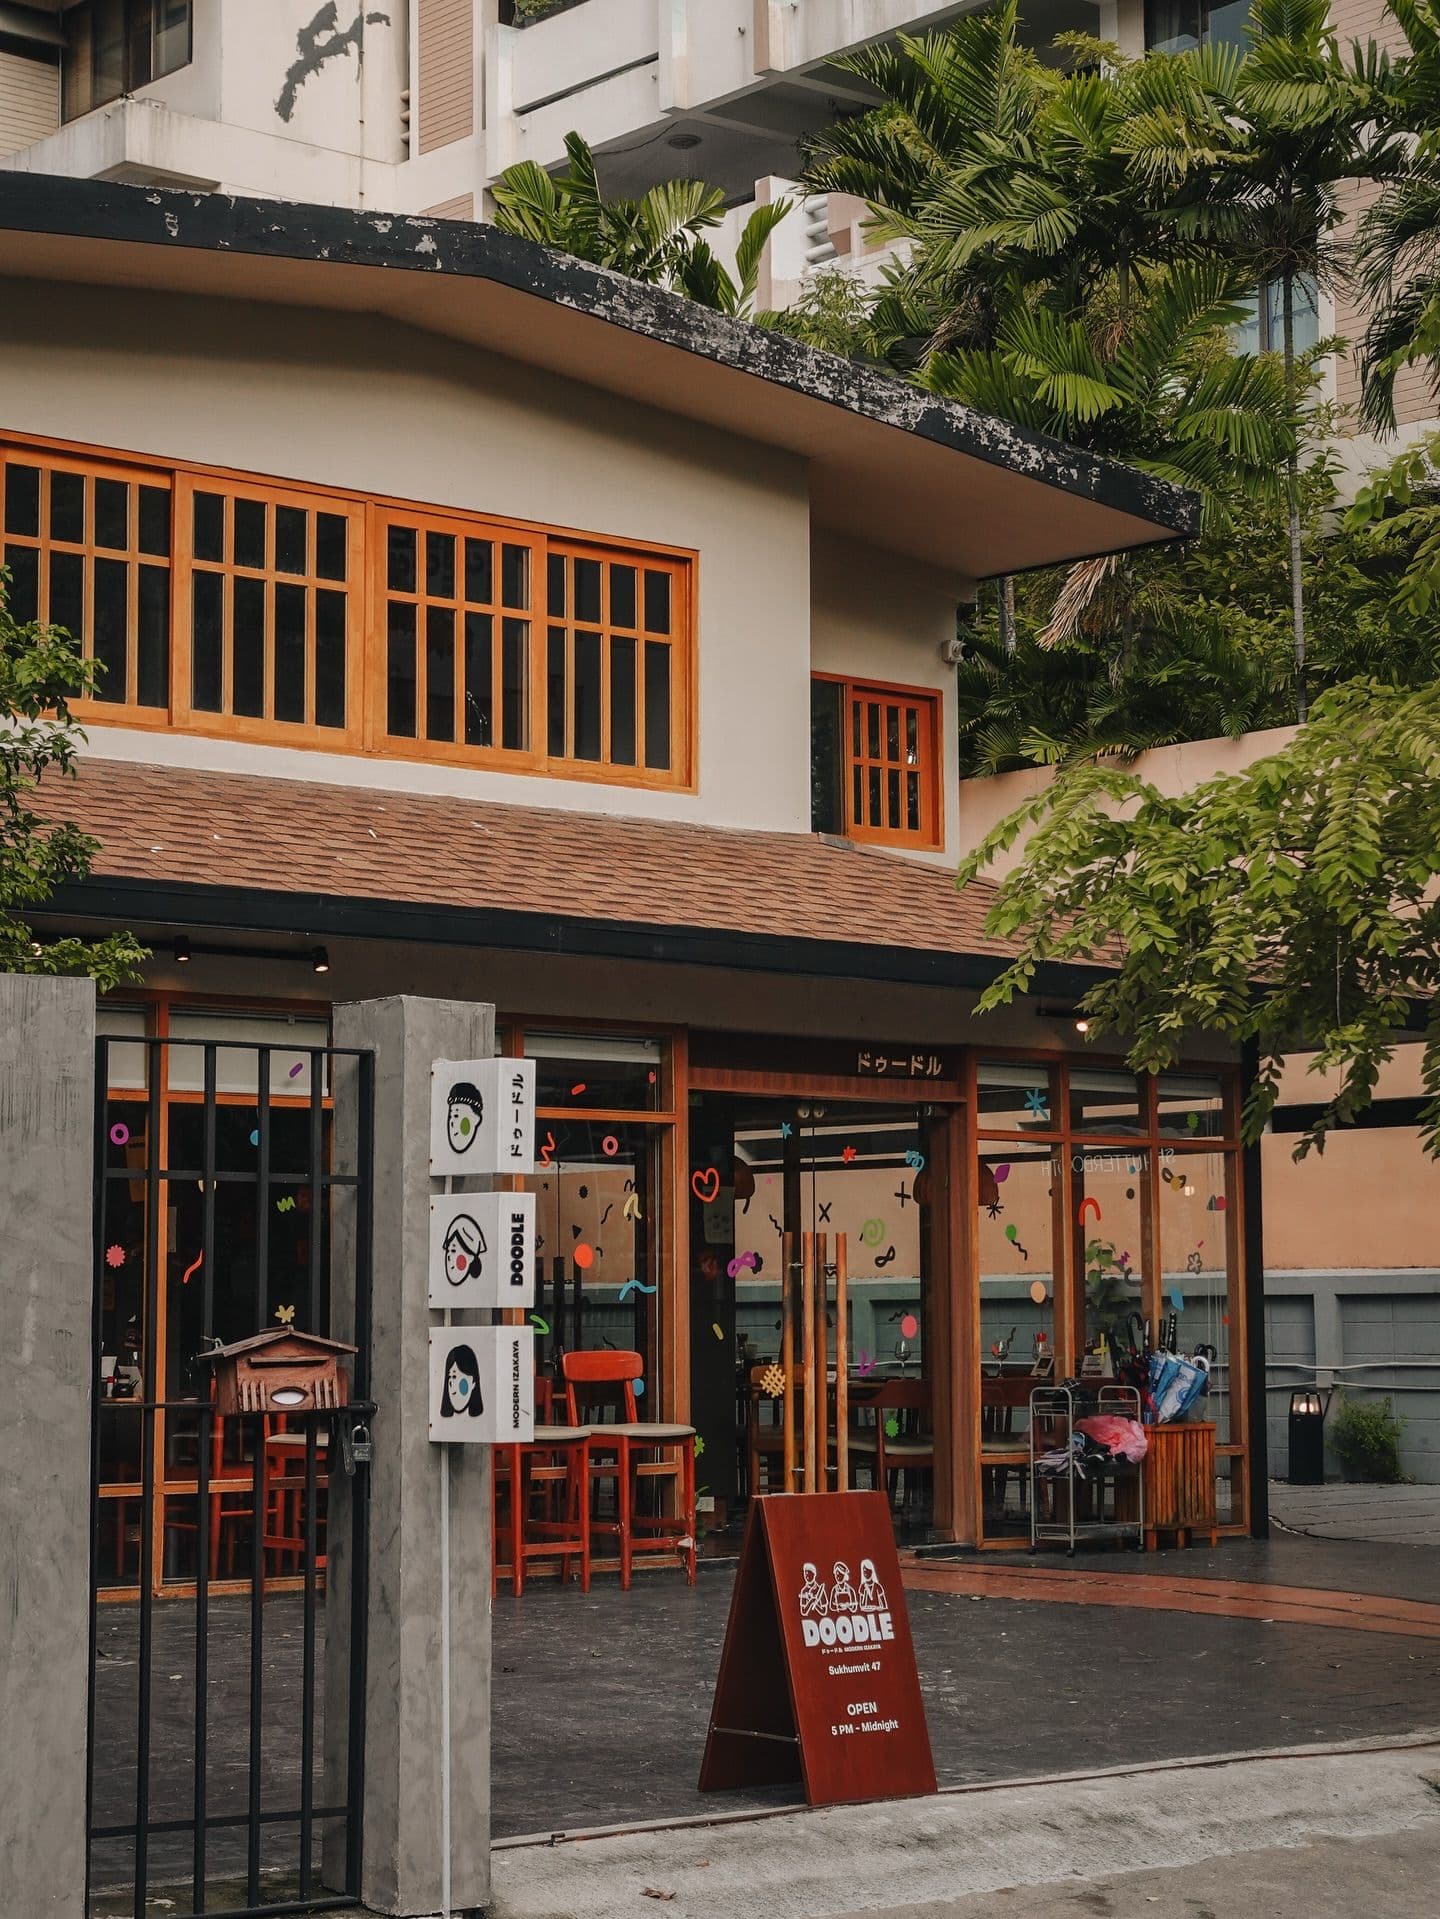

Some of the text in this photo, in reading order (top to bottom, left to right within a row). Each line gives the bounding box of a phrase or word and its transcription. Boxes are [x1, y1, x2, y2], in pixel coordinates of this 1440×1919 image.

[857, 1052, 942, 1075] ドゥードル
[510, 1073, 524, 1157] ドゥードル
[510, 1213, 525, 1286] DOODLE
[512, 1340, 520, 1429] MODERN IZAKAYA
[801, 1612, 895, 1648] DOODLE
[829, 1661, 881, 1675] Sukhumvit 47
[847, 1702, 877, 1716] OPEN
[831, 1725, 837, 1736] 5
[839, 1723, 854, 1735] PM
[861, 1719, 899, 1732] Midnight
